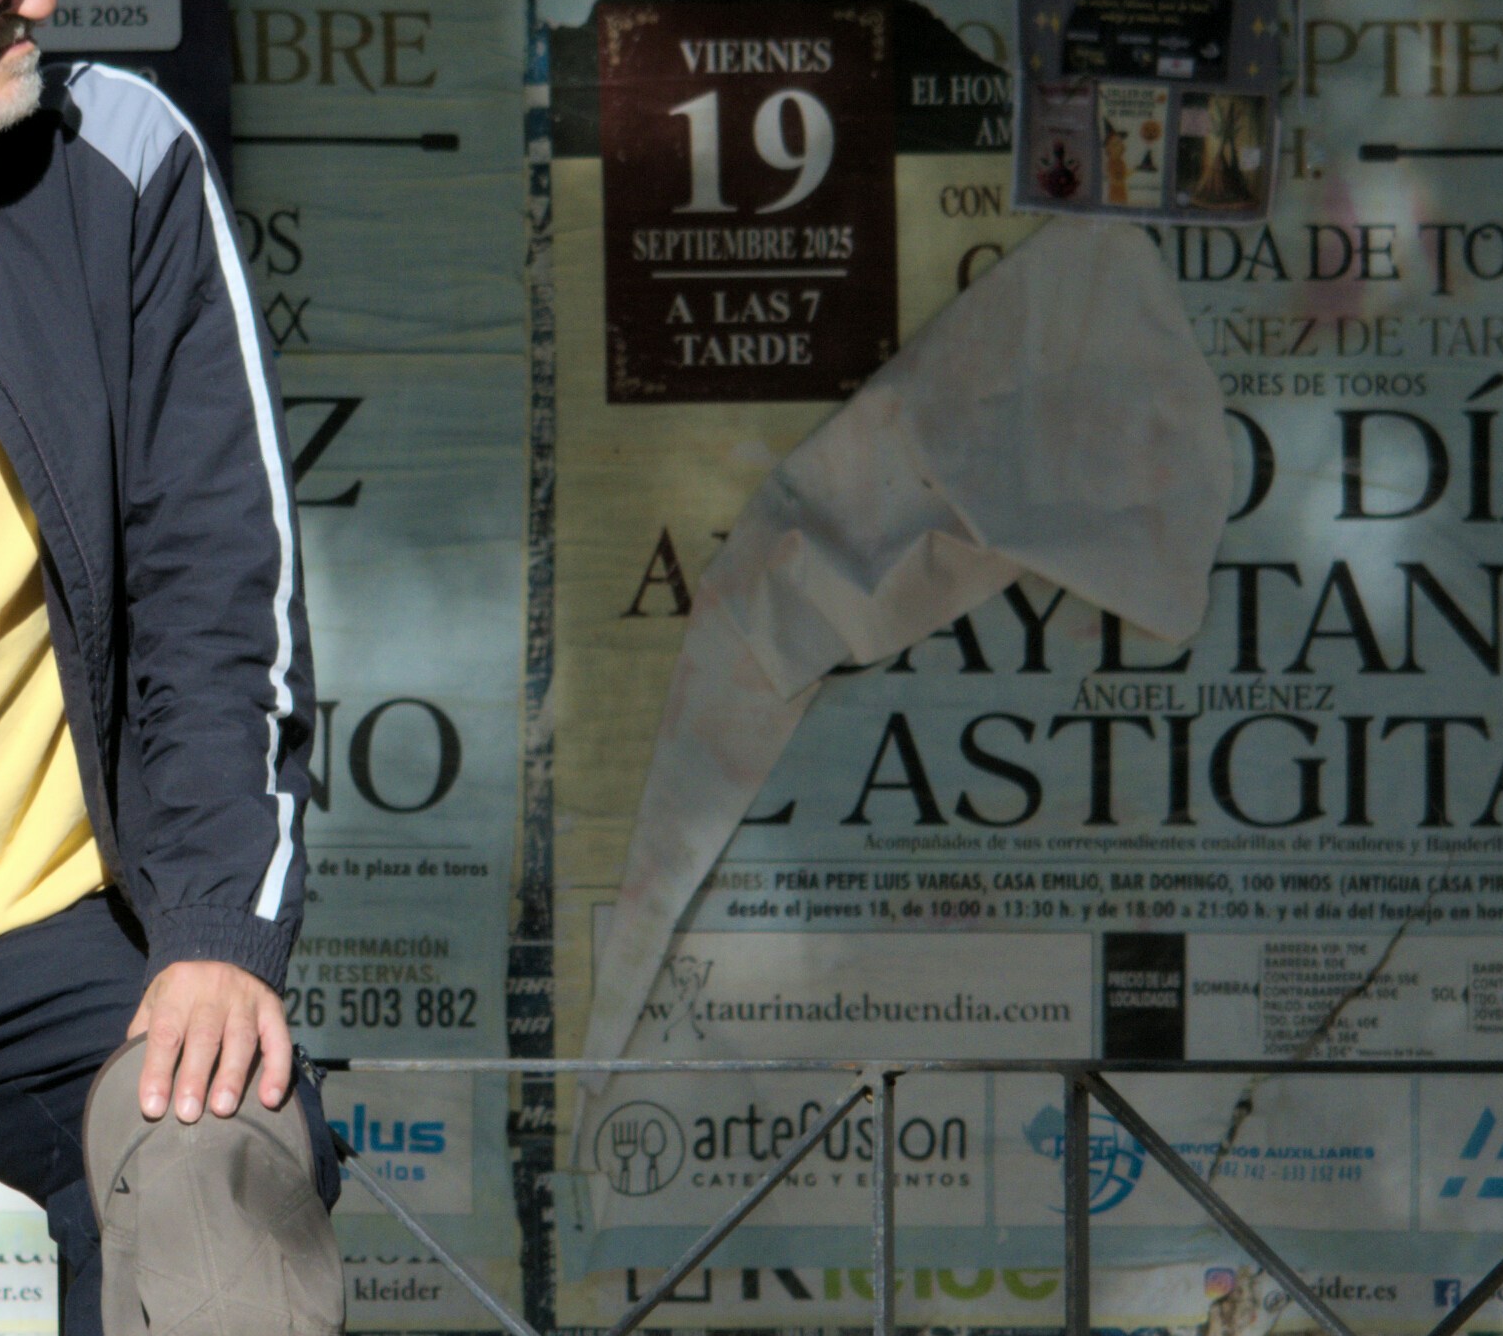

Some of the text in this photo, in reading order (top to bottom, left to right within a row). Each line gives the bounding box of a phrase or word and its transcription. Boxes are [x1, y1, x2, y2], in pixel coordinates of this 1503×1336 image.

[680, 38, 833, 75] VIERNES
[669, 87, 836, 216] 19
[632, 225, 854, 263] SEPTIEMBRE 2025
[1306, 223, 1401, 284] DE
[665, 290, 824, 324] A LAS 7
[1193, 304, 1320, 358] ÚÑEZ
[1336, 316, 1403, 359] DE
[673, 333, 812, 366] TARDE
[1293, 373, 1427, 398] DE TOROS
[1073, 675, 1335, 717] ÁNGEL JIMÉNEZ
[864, 832, 981, 855] Acompañados
[1047, 834, 1196, 855] correspondientes
[1321, 834, 1405, 853] Picadores
[366, 857, 489, 882] plaza toros
[825, 872, 1332, 893] PEPE LUIS VINOS
[1003, 900, 1054, 919] 13:30
[297, 932, 450, 961] NFORMACIÓN
[340, 989, 478, 1029] 503 882
[639, 992, 1072, 1025] w.taurinadebuendia.com
[694, 1100, 968, 1164] artefuson
[1264, 1145, 1374, 1160] AUXILIARES
[857, 1172, 970, 1189] EENTOS
[354, 1276, 443, 1304] kleider
